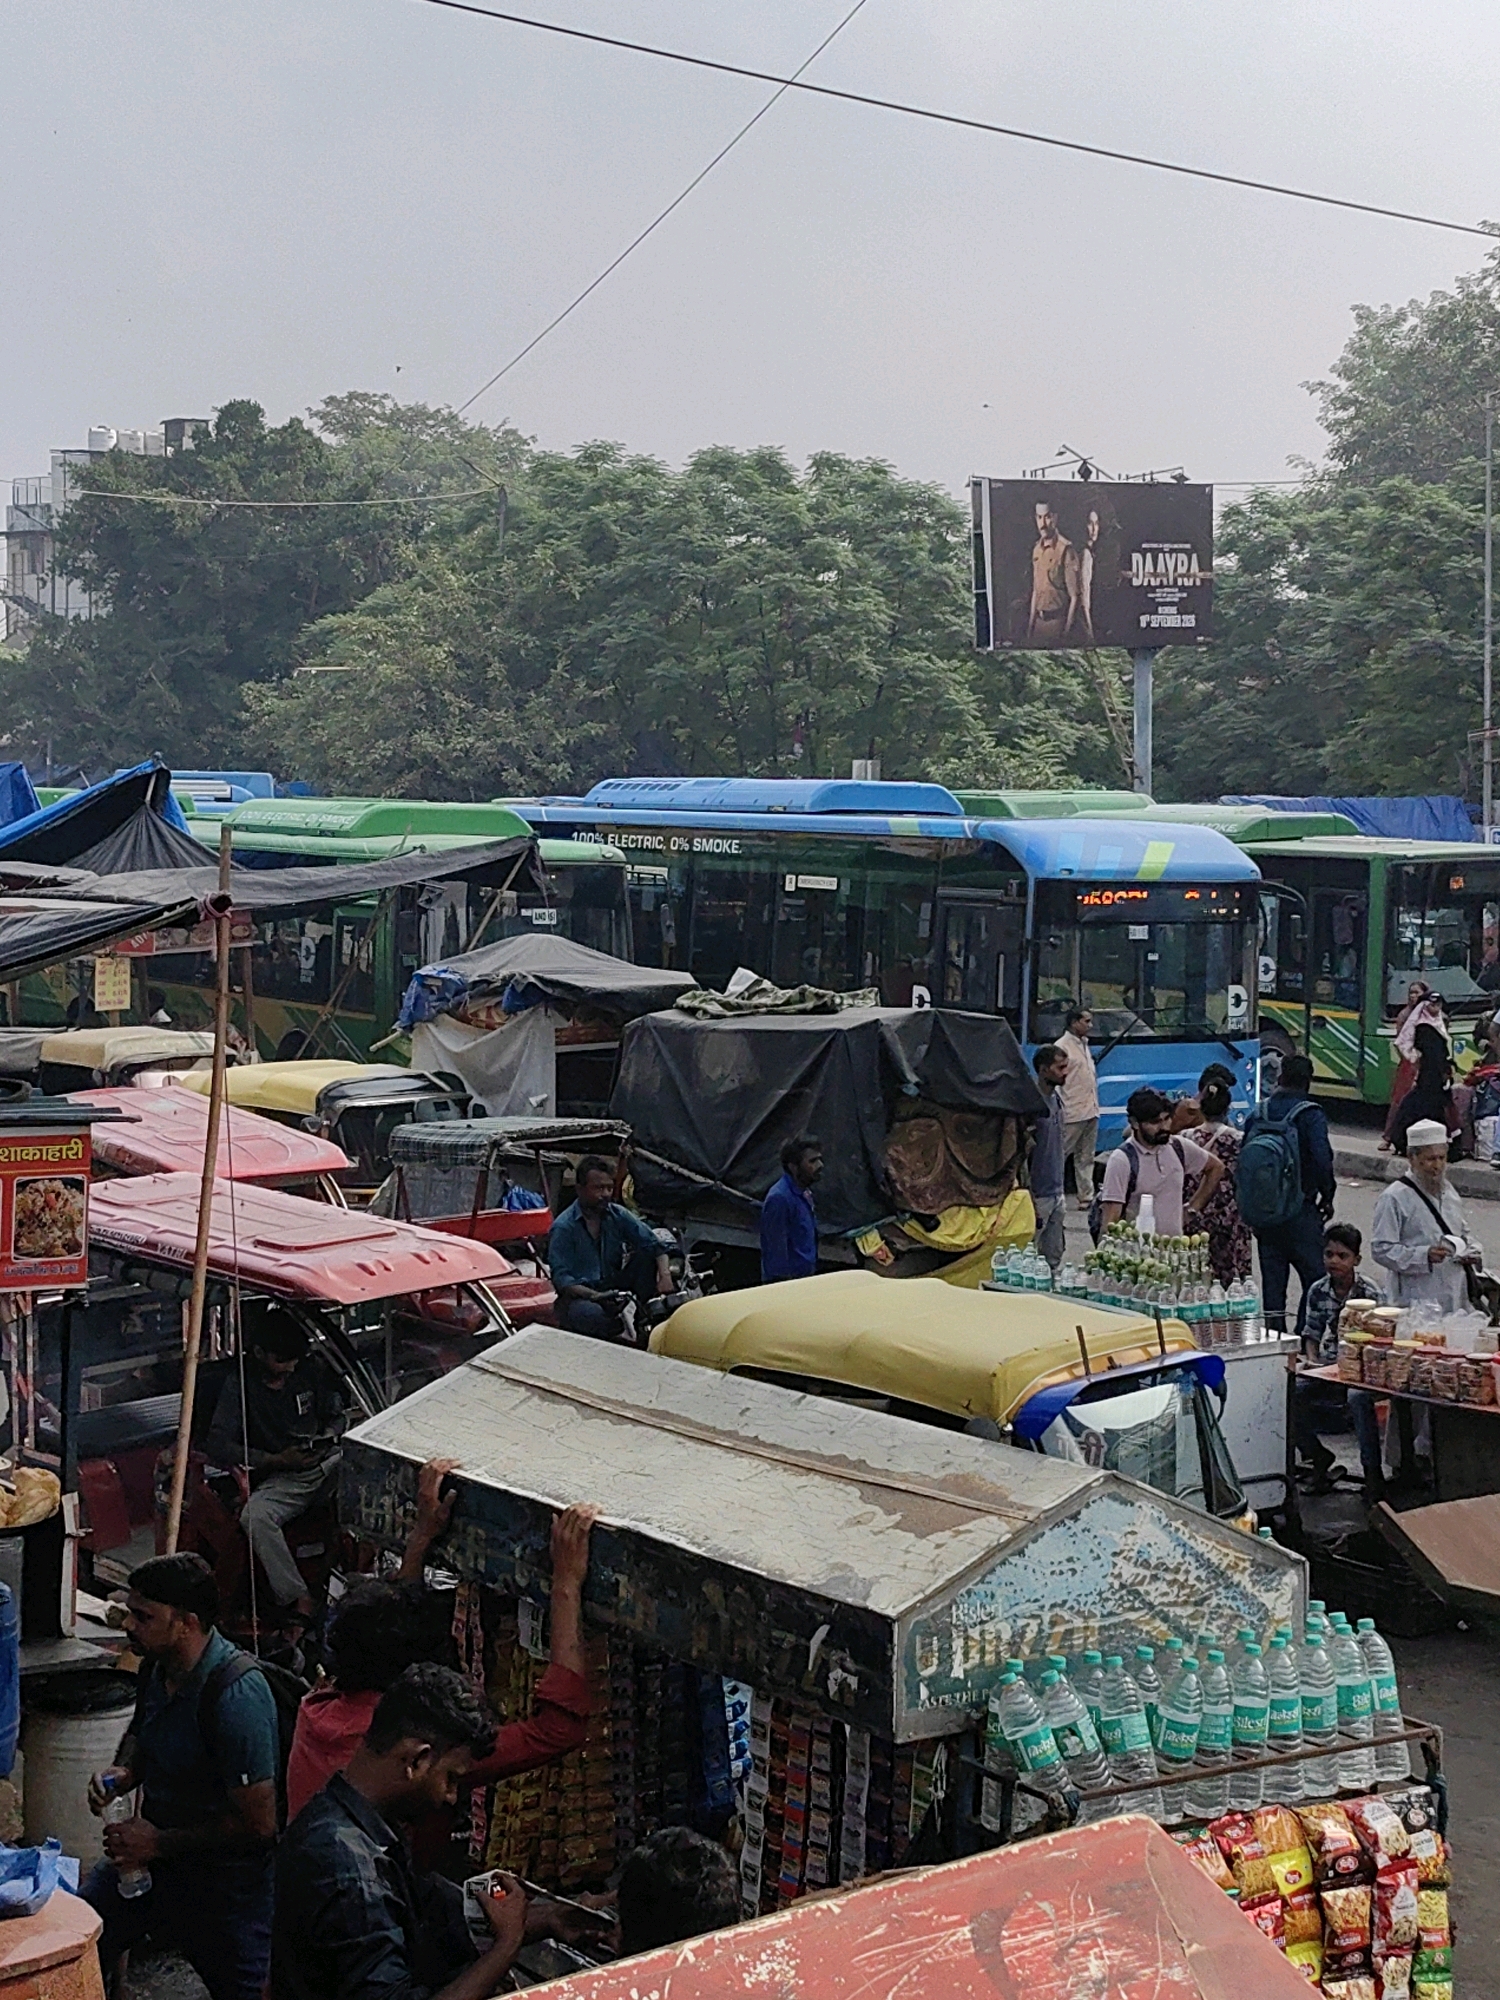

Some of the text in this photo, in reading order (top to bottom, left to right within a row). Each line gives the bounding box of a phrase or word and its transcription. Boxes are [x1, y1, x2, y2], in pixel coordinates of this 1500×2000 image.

[1131, 552, 1201, 586] DAAYRA
[670, 837, 690, 851] 0%
[692, 838, 743, 854] SMOKE.
[0, 1138, 83, 1162] शाकाहारी
